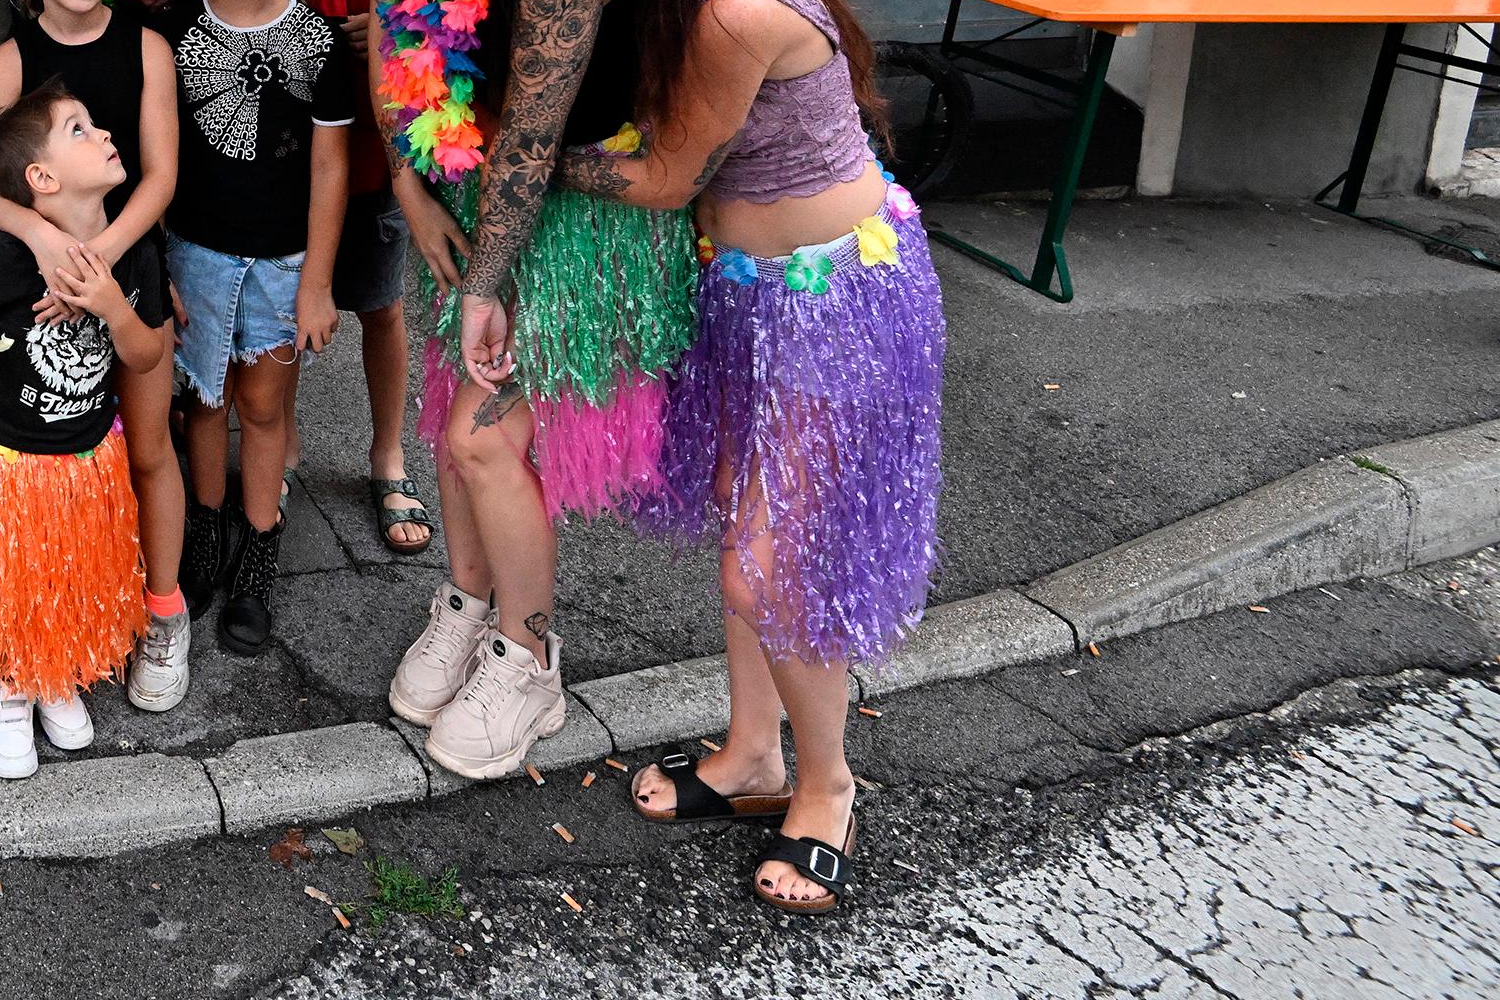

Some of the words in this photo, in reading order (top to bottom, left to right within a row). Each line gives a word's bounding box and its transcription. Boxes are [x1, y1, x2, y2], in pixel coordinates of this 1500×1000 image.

[174, 27, 203, 66] GANG
[187, 34, 211, 67] GANG
[194, 68, 206, 99] GURU
[226, 126, 257, 141] GURU
[231, 119, 258, 133] GURU
[216, 141, 256, 161] GURU
[222, 133, 256, 150] GURU
[21, 388, 37, 403] GO
[40, 392, 95, 416] Tigers
